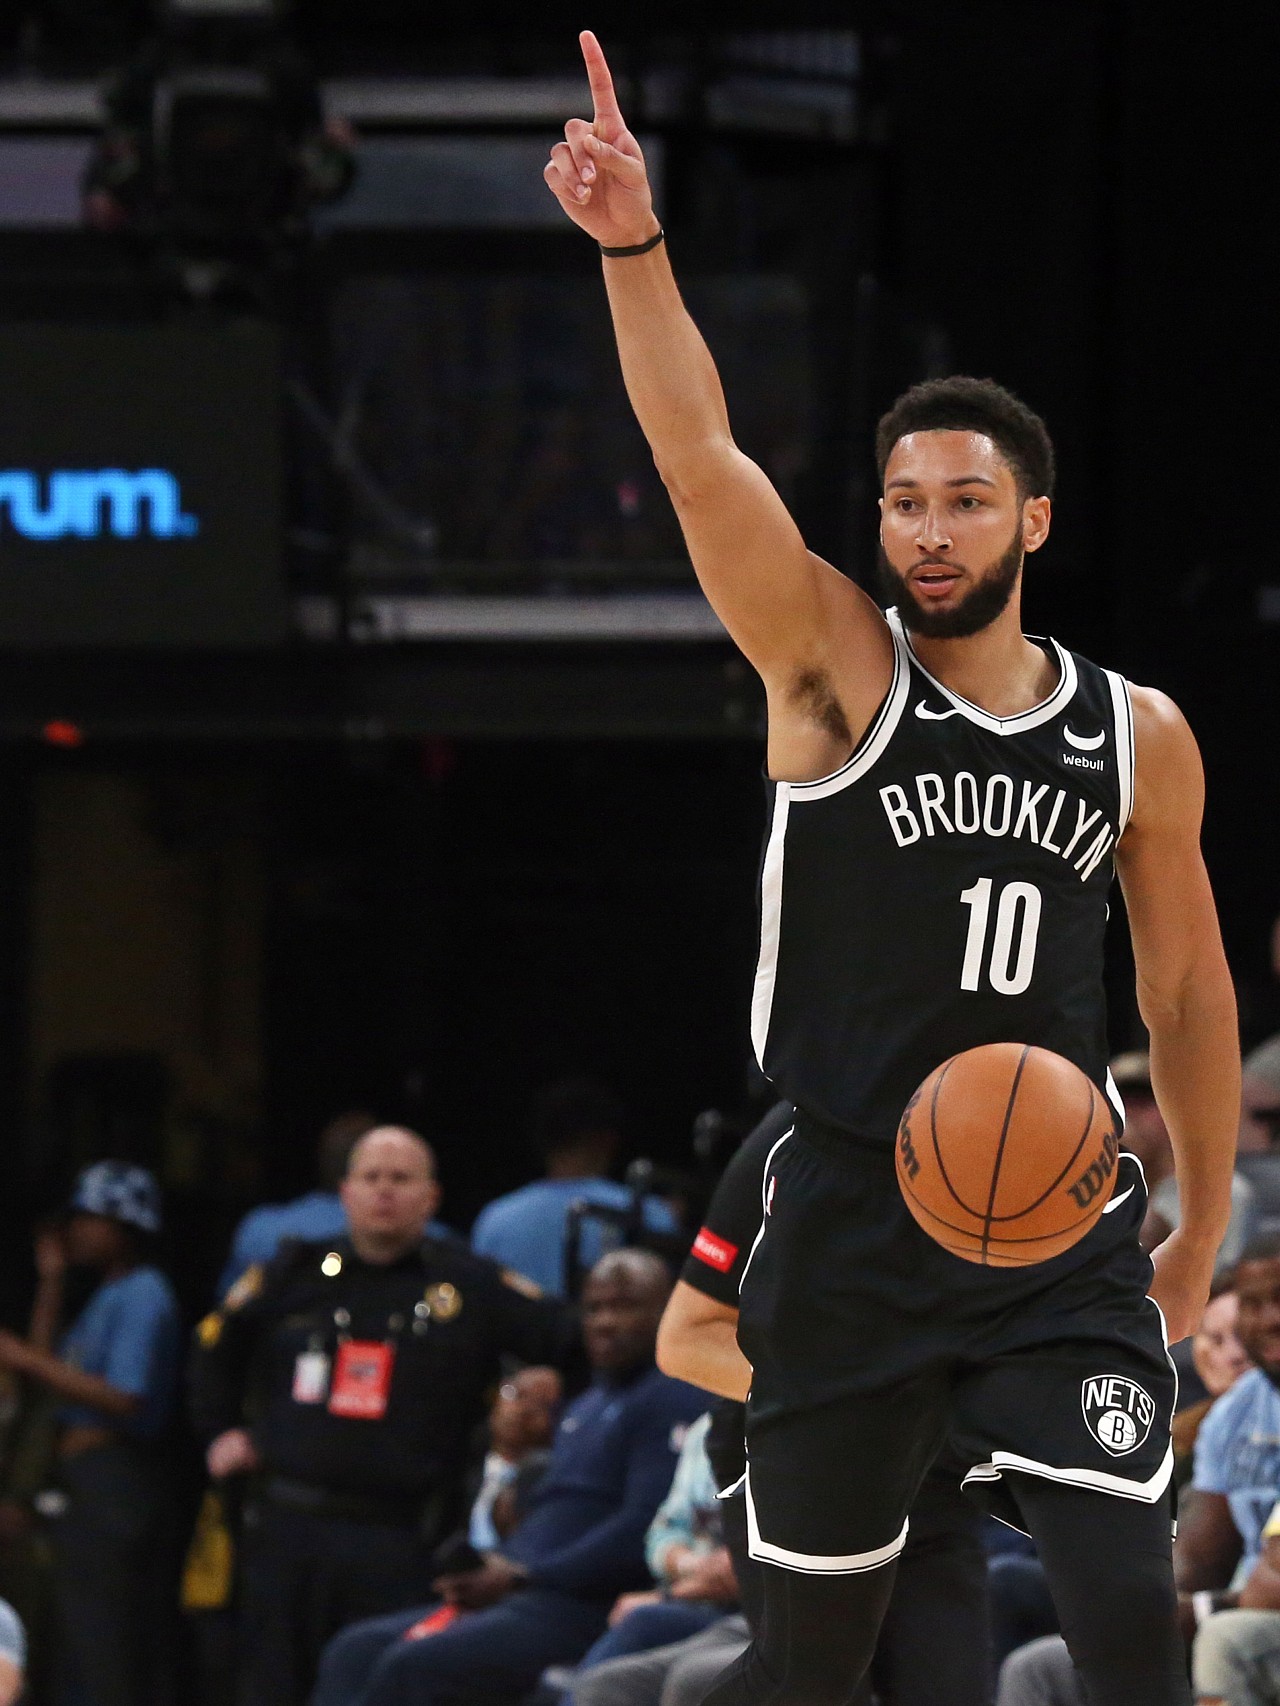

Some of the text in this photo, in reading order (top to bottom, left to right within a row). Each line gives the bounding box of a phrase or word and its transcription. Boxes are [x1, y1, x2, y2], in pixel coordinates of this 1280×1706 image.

[1062, 753, 1105, 772] Webull
[878, 771, 1115, 883] BROOKLYN
[960, 877, 1042, 996] 10
[1085, 1378, 1152, 1427] NETS
[1110, 1415, 1126, 1445] B
